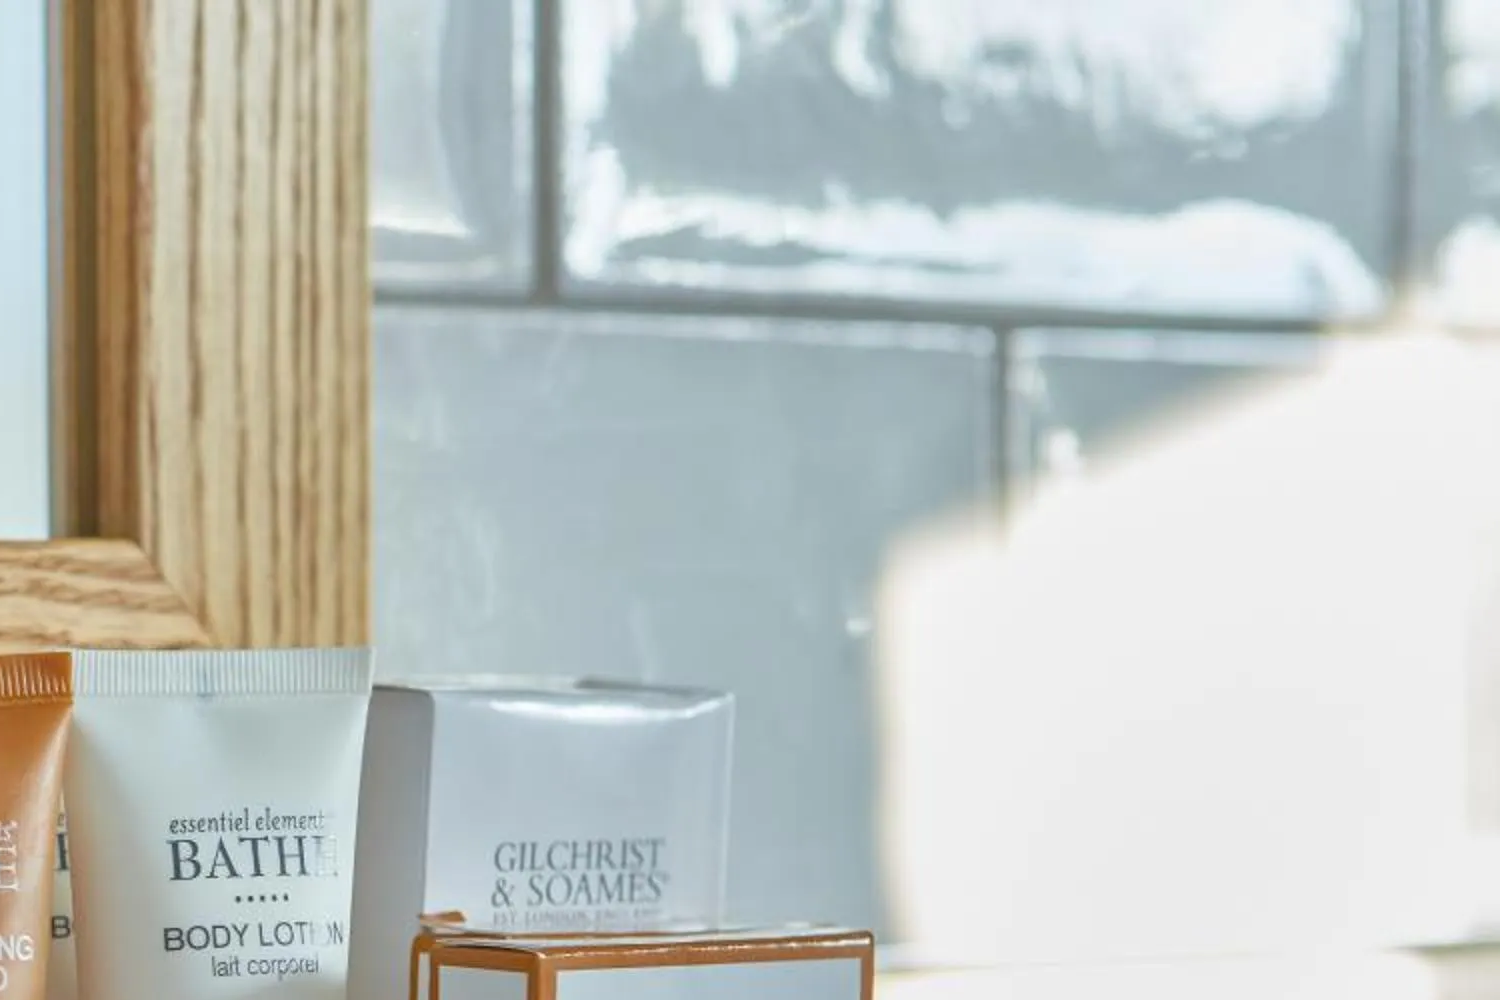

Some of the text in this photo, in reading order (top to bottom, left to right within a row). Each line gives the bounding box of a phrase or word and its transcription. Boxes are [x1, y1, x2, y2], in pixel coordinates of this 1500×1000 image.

[169, 806, 328, 835] essentiel element
[494, 838, 666, 872] GILCHRIST
[490, 872, 663, 908] & SOAMES
[163, 923, 250, 952] BODY
[211, 954, 320, 982] lait corporel
